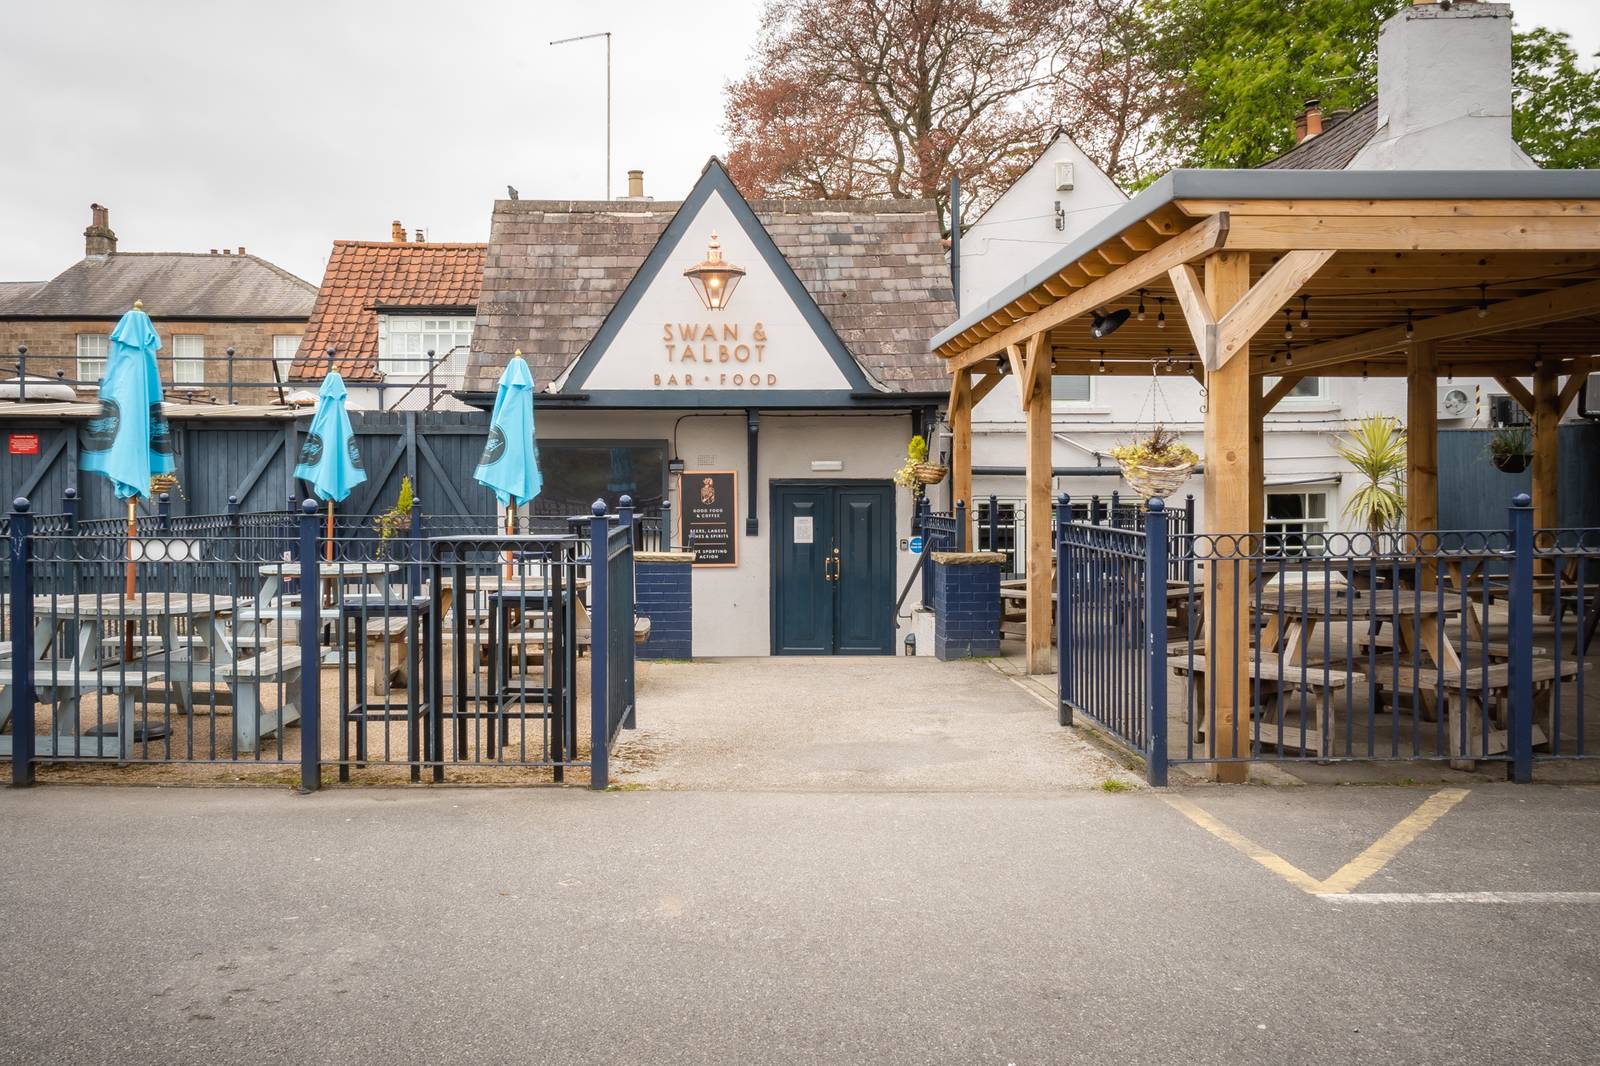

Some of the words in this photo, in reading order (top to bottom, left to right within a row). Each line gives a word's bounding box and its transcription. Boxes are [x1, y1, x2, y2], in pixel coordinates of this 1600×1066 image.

[663, 323, 738, 341] SWAN
[753, 322, 768, 341] &
[664, 344, 766, 363] TALBOT
[654, 373, 692, 386] BAR
[720, 373, 777, 386] FOOD
